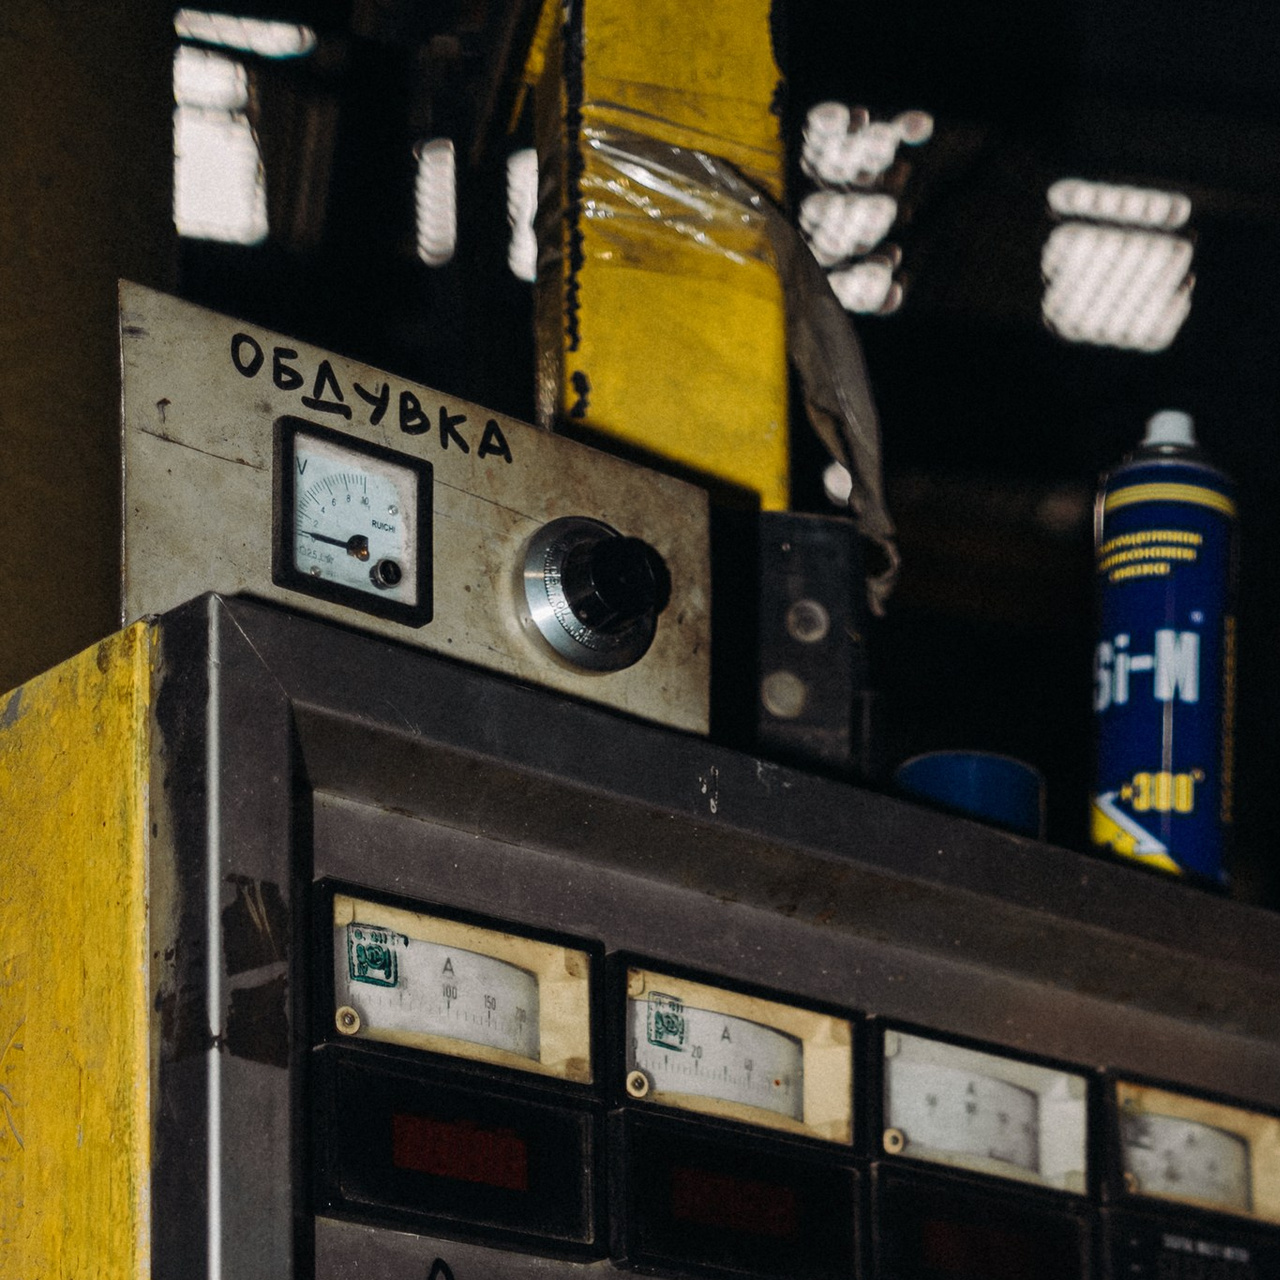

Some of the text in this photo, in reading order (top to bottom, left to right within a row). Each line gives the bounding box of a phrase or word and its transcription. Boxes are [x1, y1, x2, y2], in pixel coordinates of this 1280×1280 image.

[231, 332, 513, 464] ОБДУВКА
[296, 457, 308, 475] V
[371, 519, 396, 534] RUICHI
[442, 956, 455, 977] A
[442, 983, 458, 1001] 100
[721, 1025, 732, 1043] A
